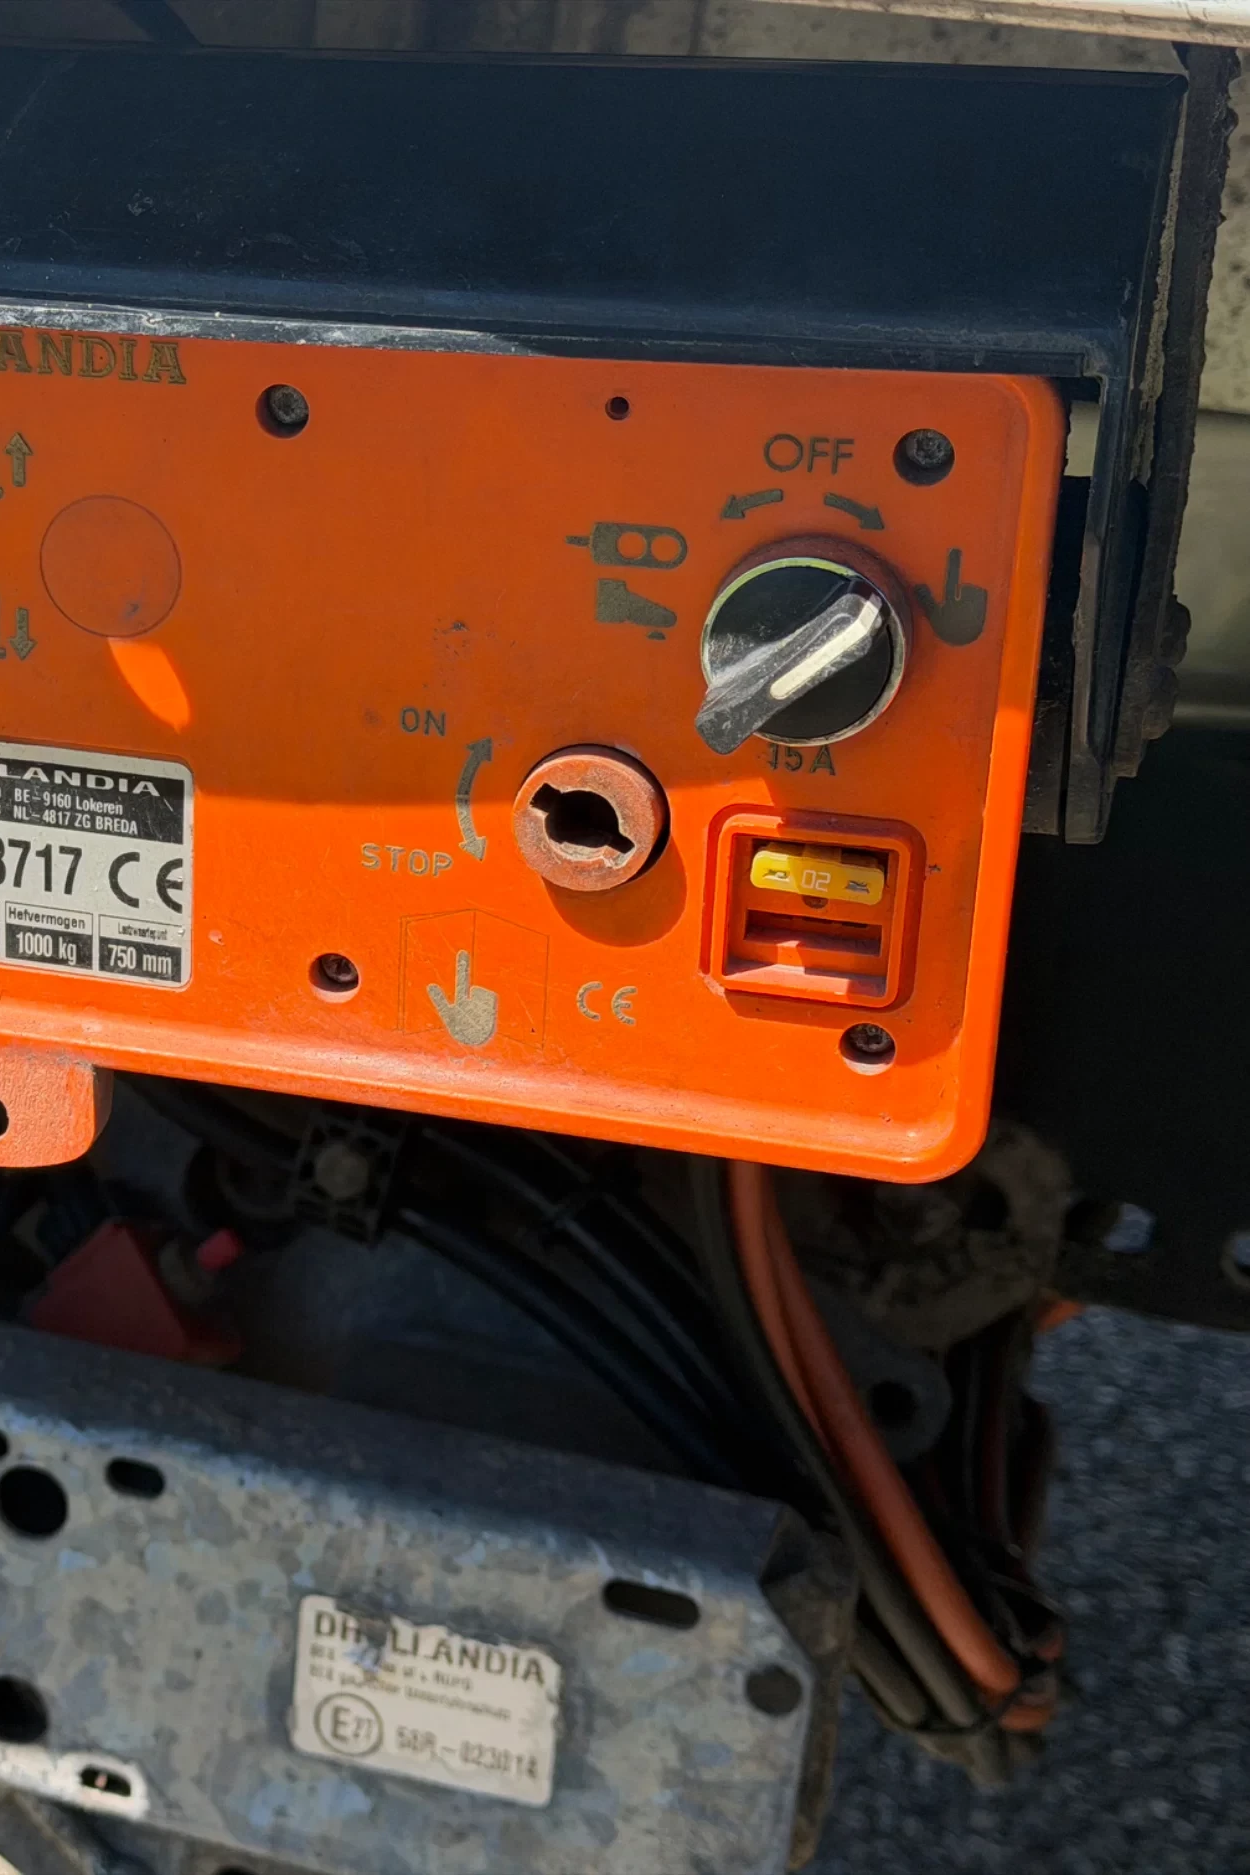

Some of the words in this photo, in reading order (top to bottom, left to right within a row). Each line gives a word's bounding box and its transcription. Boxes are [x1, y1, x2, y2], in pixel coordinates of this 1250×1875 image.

[764, 434, 855, 474] OFF
[401, 707, 446, 736] ON
[76, 796, 123, 815] Lokeren
[74, 813, 91, 829] ZG
[95, 817, 138, 835] BREDA
[361, 843, 453, 876] STOP
[8, 907, 85, 930] Hefvermogen
[16, 931, 52, 958] 1000
[58, 936, 77, 966] kg
[108, 944, 137, 970] 750
[143, 953, 172, 975] mm
[314, 1610, 545, 1685] DHLLANDIA
